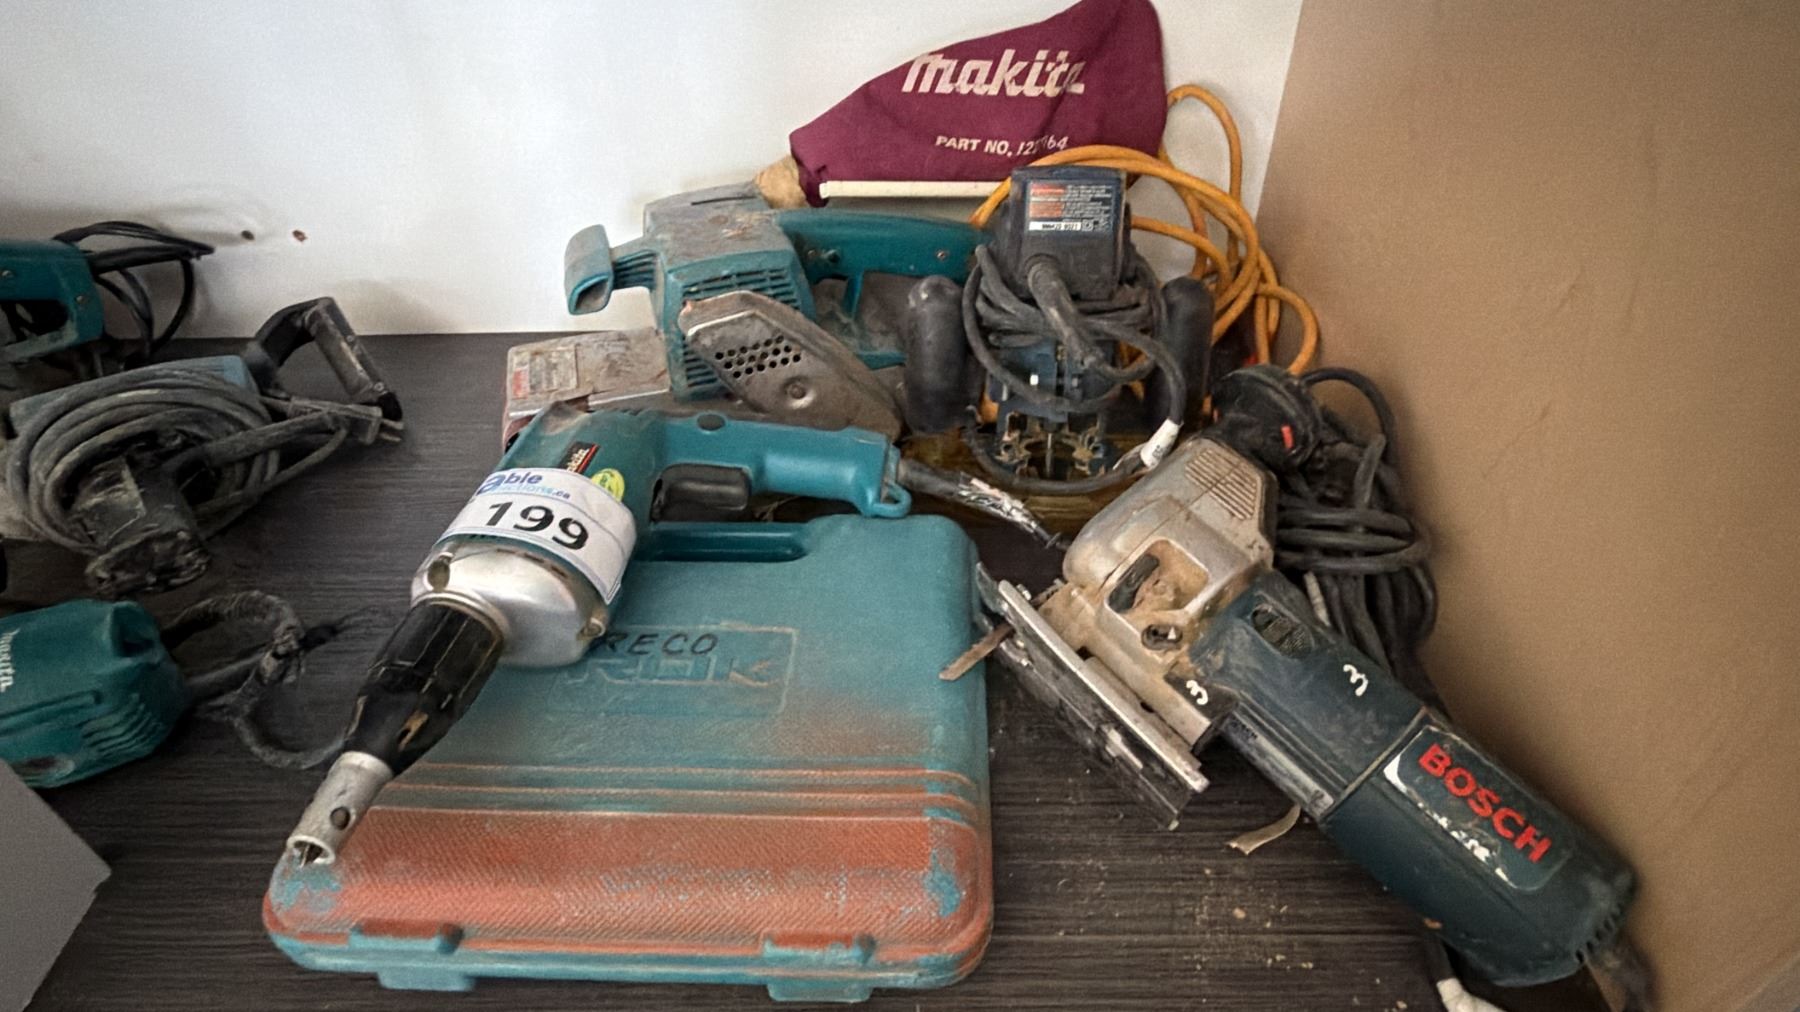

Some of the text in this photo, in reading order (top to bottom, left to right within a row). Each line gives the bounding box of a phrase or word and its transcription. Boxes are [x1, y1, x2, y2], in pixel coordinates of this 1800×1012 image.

[902, 48, 1086, 98] makita
[935, 135, 981, 152] PART
[983, 139, 1013, 158] NO.
[486, 501, 589, 550] 199
[1418, 743, 1552, 863] BOSCH
